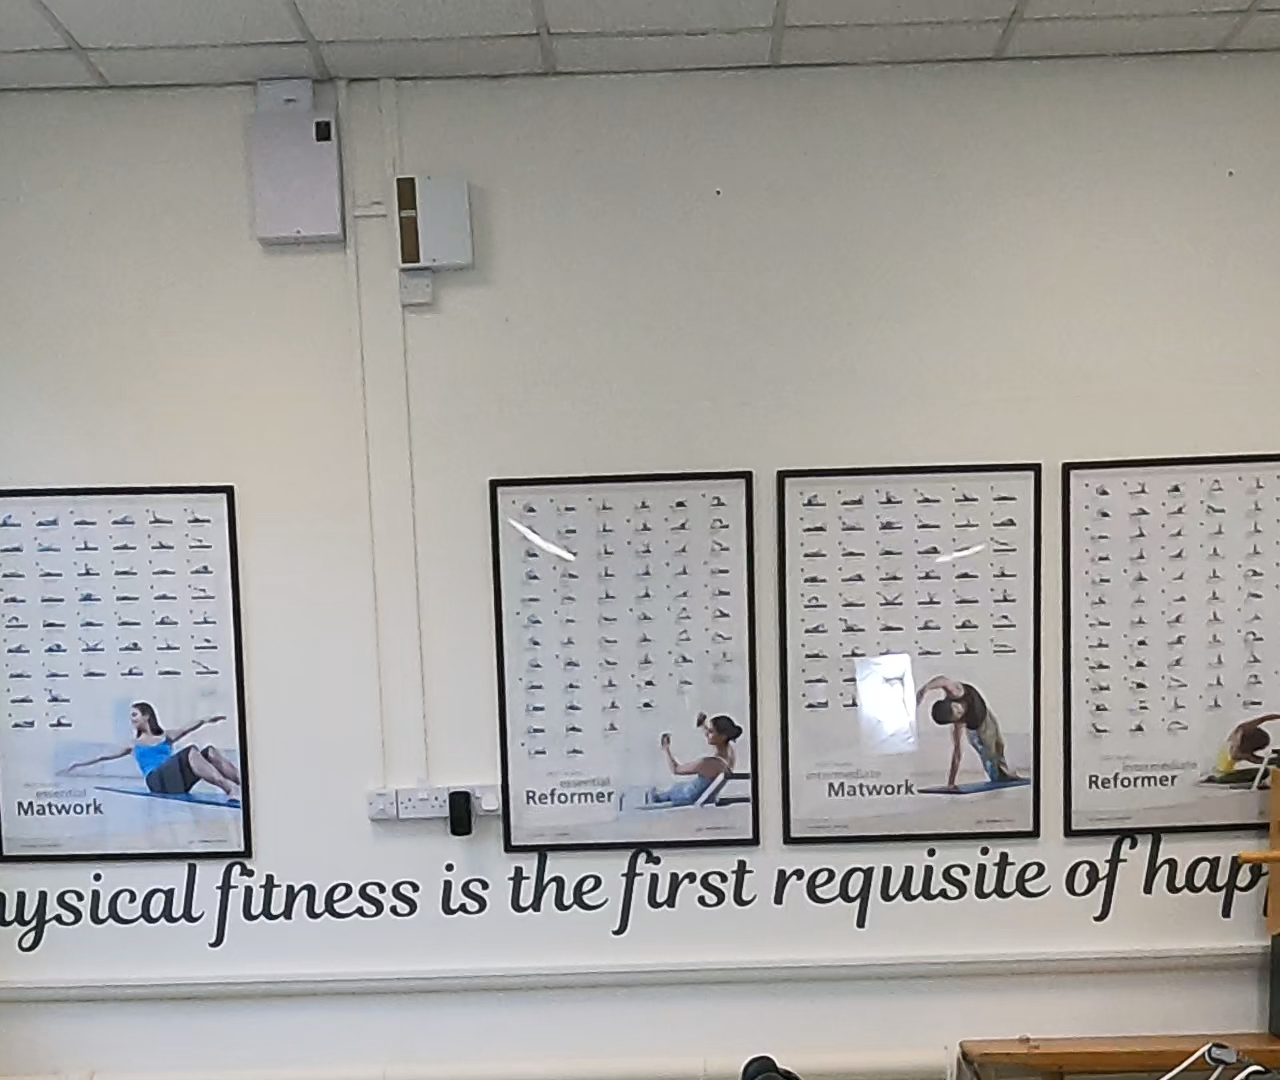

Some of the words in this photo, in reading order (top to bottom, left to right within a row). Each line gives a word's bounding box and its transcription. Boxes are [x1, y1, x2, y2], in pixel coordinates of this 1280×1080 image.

[827, 779, 916, 798] Matwork
[1087, 772, 1178, 790] Reformer
[525, 787, 615, 805] Reformer
[16, 798, 105, 817] Matwork
[208, 861, 421, 948] fitness
[441, 863, 490, 915] is
[507, 850, 609, 913] the
[612, 848, 758, 936] first
[773, 846, 1052, 929] requisite
[1065, 833, 1139, 923] of
